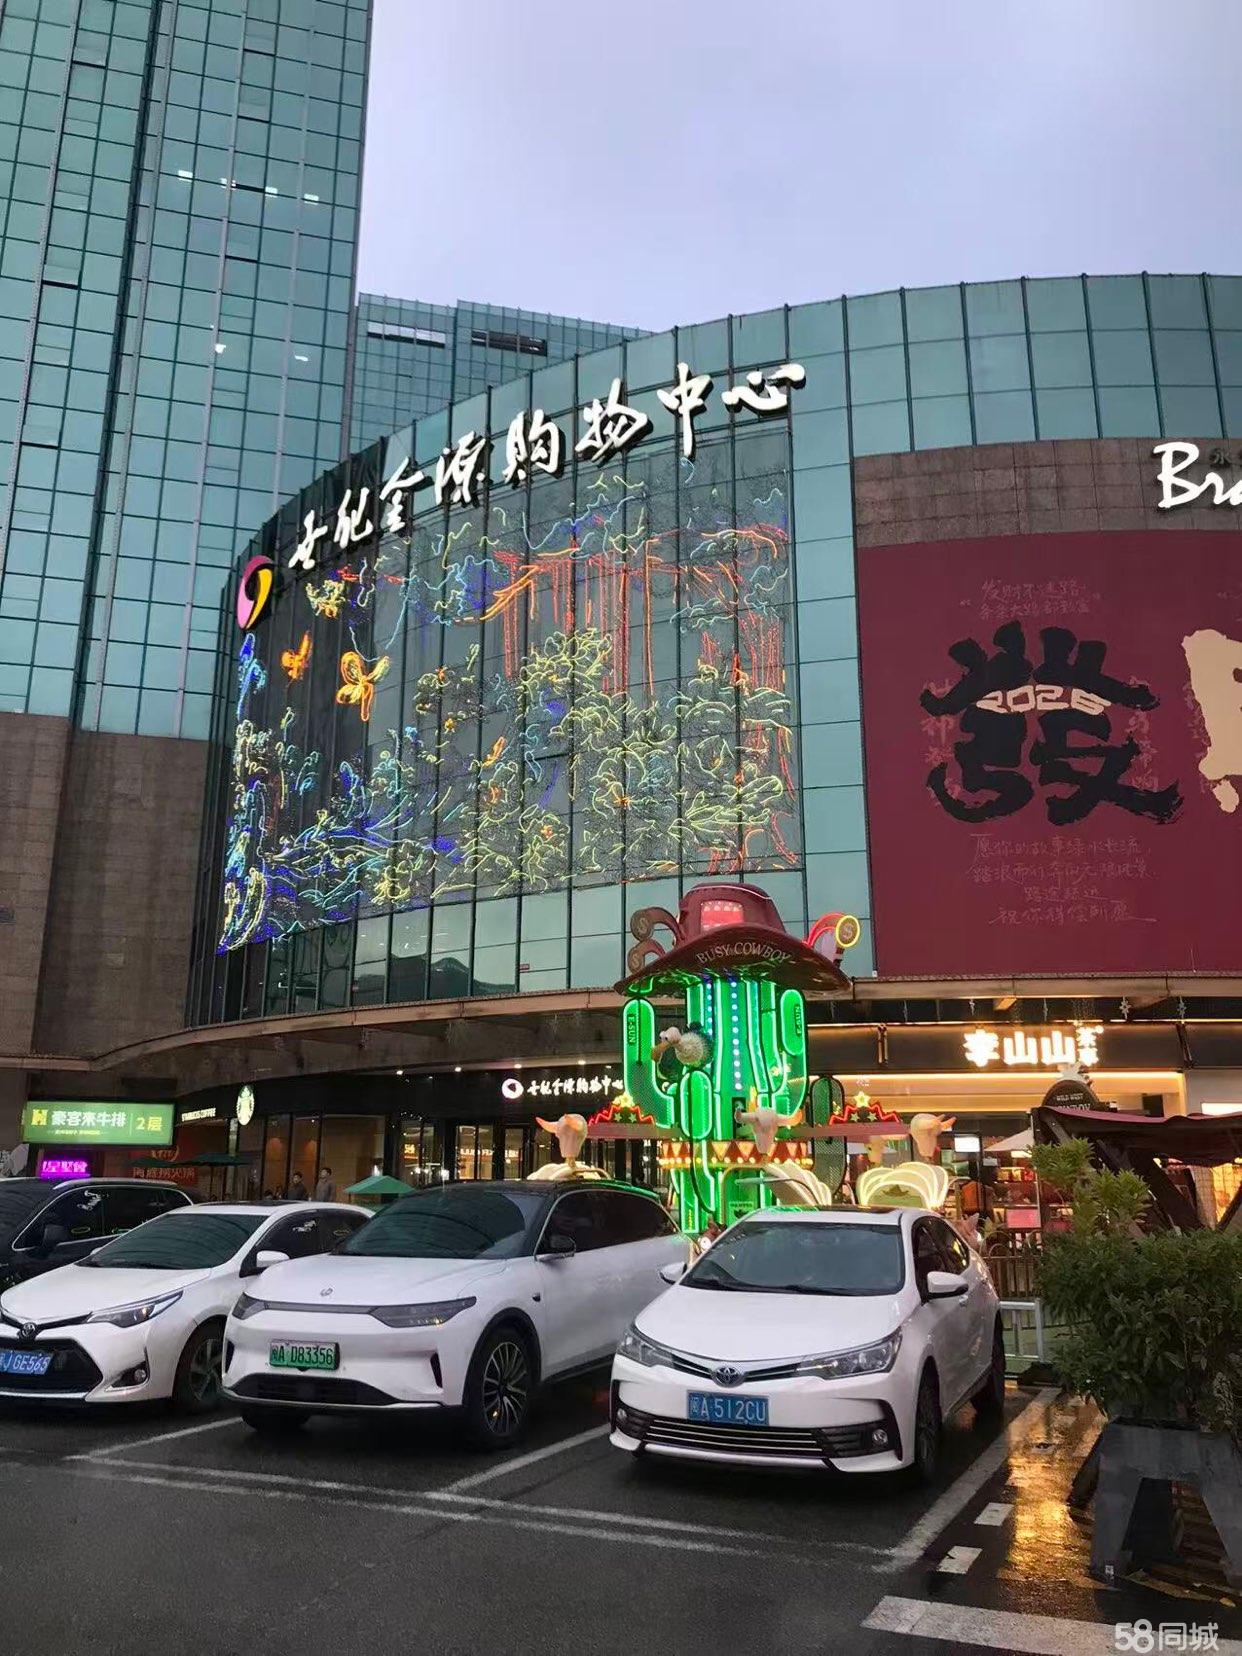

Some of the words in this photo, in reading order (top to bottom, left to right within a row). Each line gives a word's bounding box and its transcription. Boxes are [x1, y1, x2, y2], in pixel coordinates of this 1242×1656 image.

[975, 684, 1112, 716] 2026
[696, 943, 731, 964] BUSY
[733, 941, 793, 963] COWBOY
[628, 1016, 636, 1043] E-SUN
[51, 1110, 127, 1127] 豪客来牛排
[135, 1116, 163, 1132] 2层
